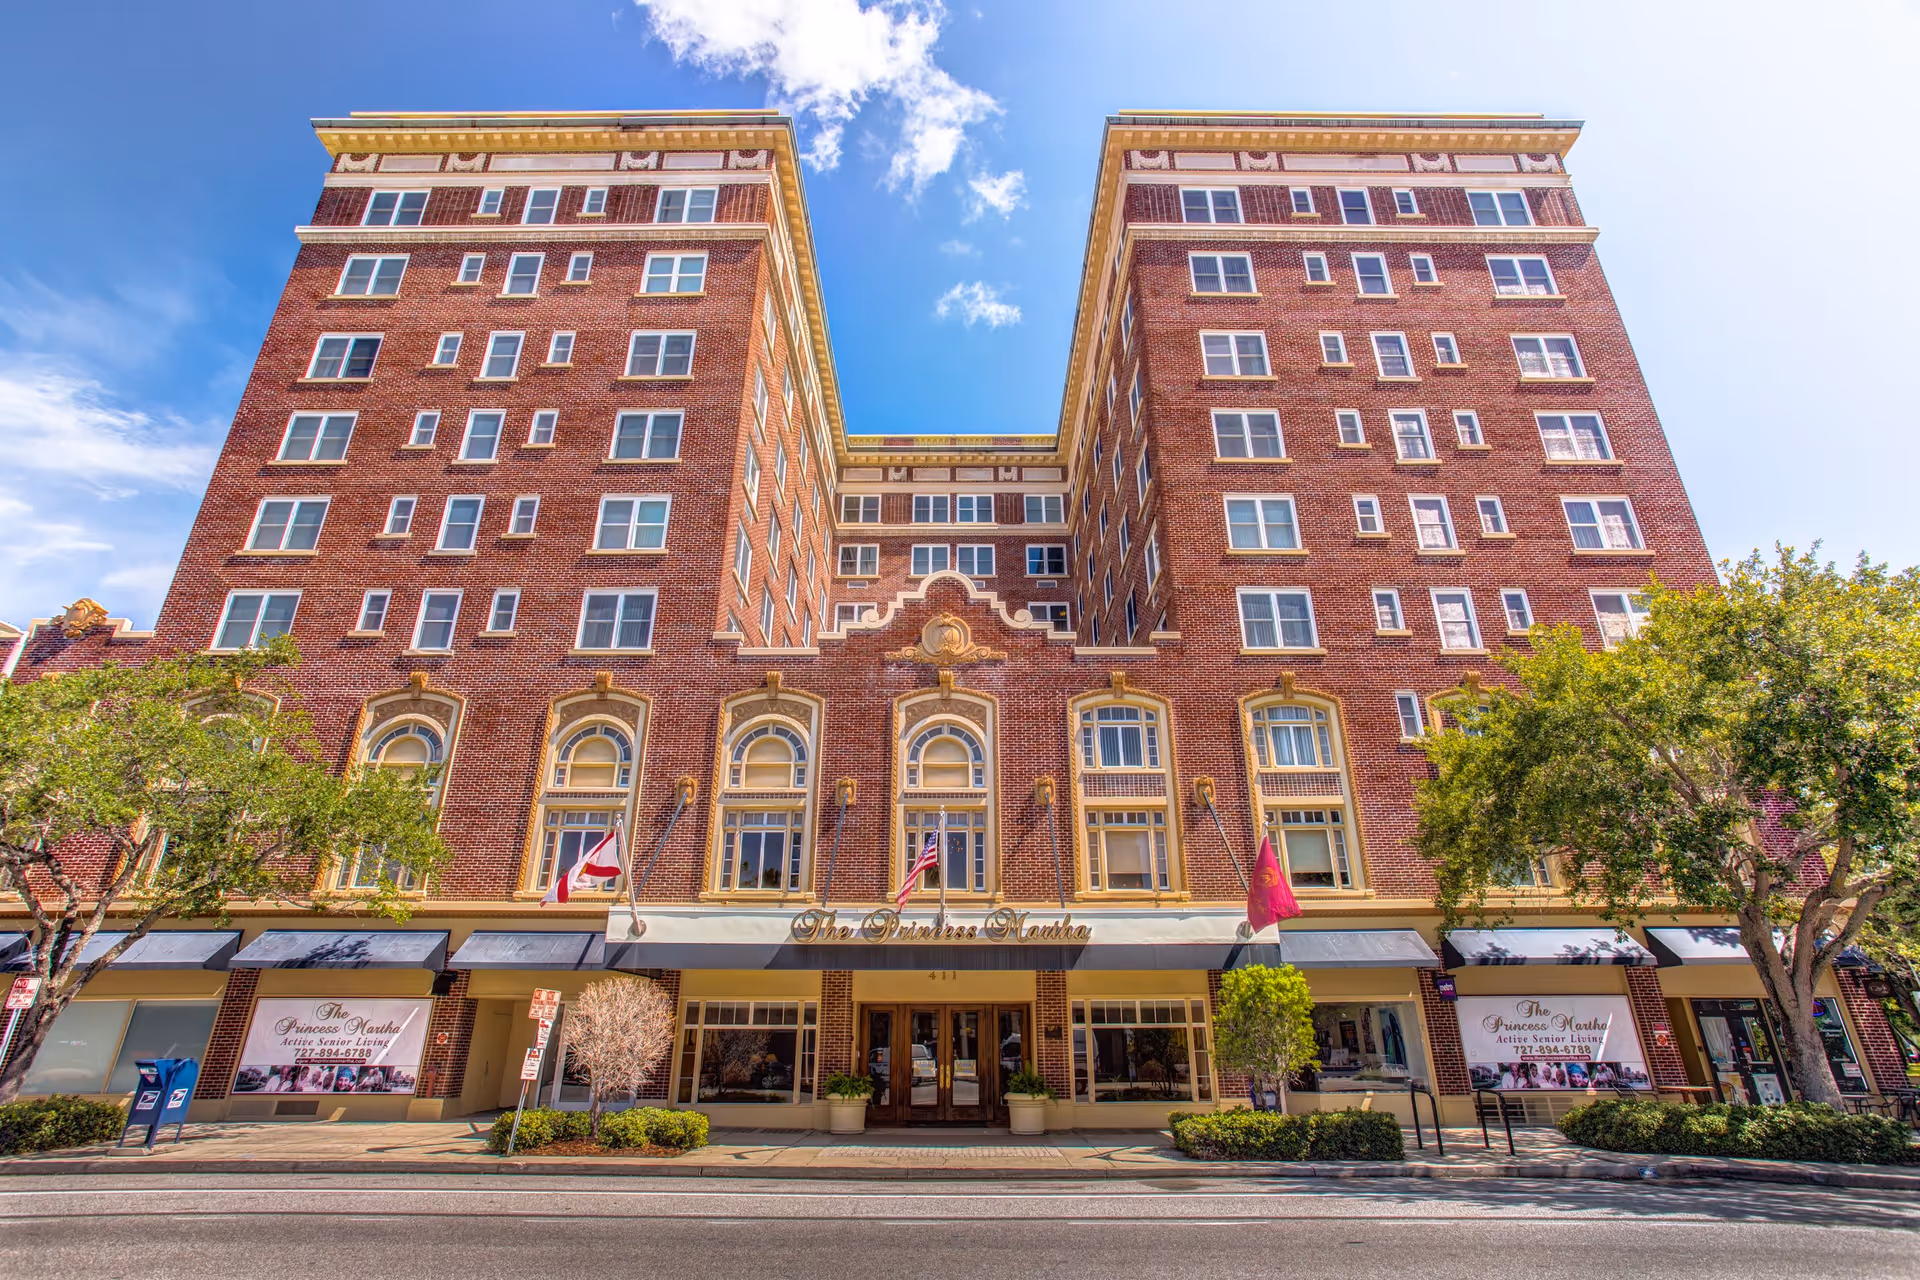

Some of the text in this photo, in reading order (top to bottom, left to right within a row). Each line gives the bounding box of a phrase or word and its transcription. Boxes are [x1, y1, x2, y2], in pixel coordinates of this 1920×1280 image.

[790, 907, 1092, 943] The Princess Martha
[928, 970, 957, 981] 411
[16, 980, 28, 988] NO
[316, 1002, 350, 1020] The
[1516, 1000, 1551, 1018] The
[275, 1016, 402, 1036] Princess Martha
[1482, 1013, 1609, 1033] Princess Martha
[280, 1037, 390, 1049] Active Senior Living
[1496, 1034, 1605, 1046] Active Senior Living
[294, 1048, 373, 1058] 727-894-6788
[1513, 1045, 1592, 1055] 727-894-6788
